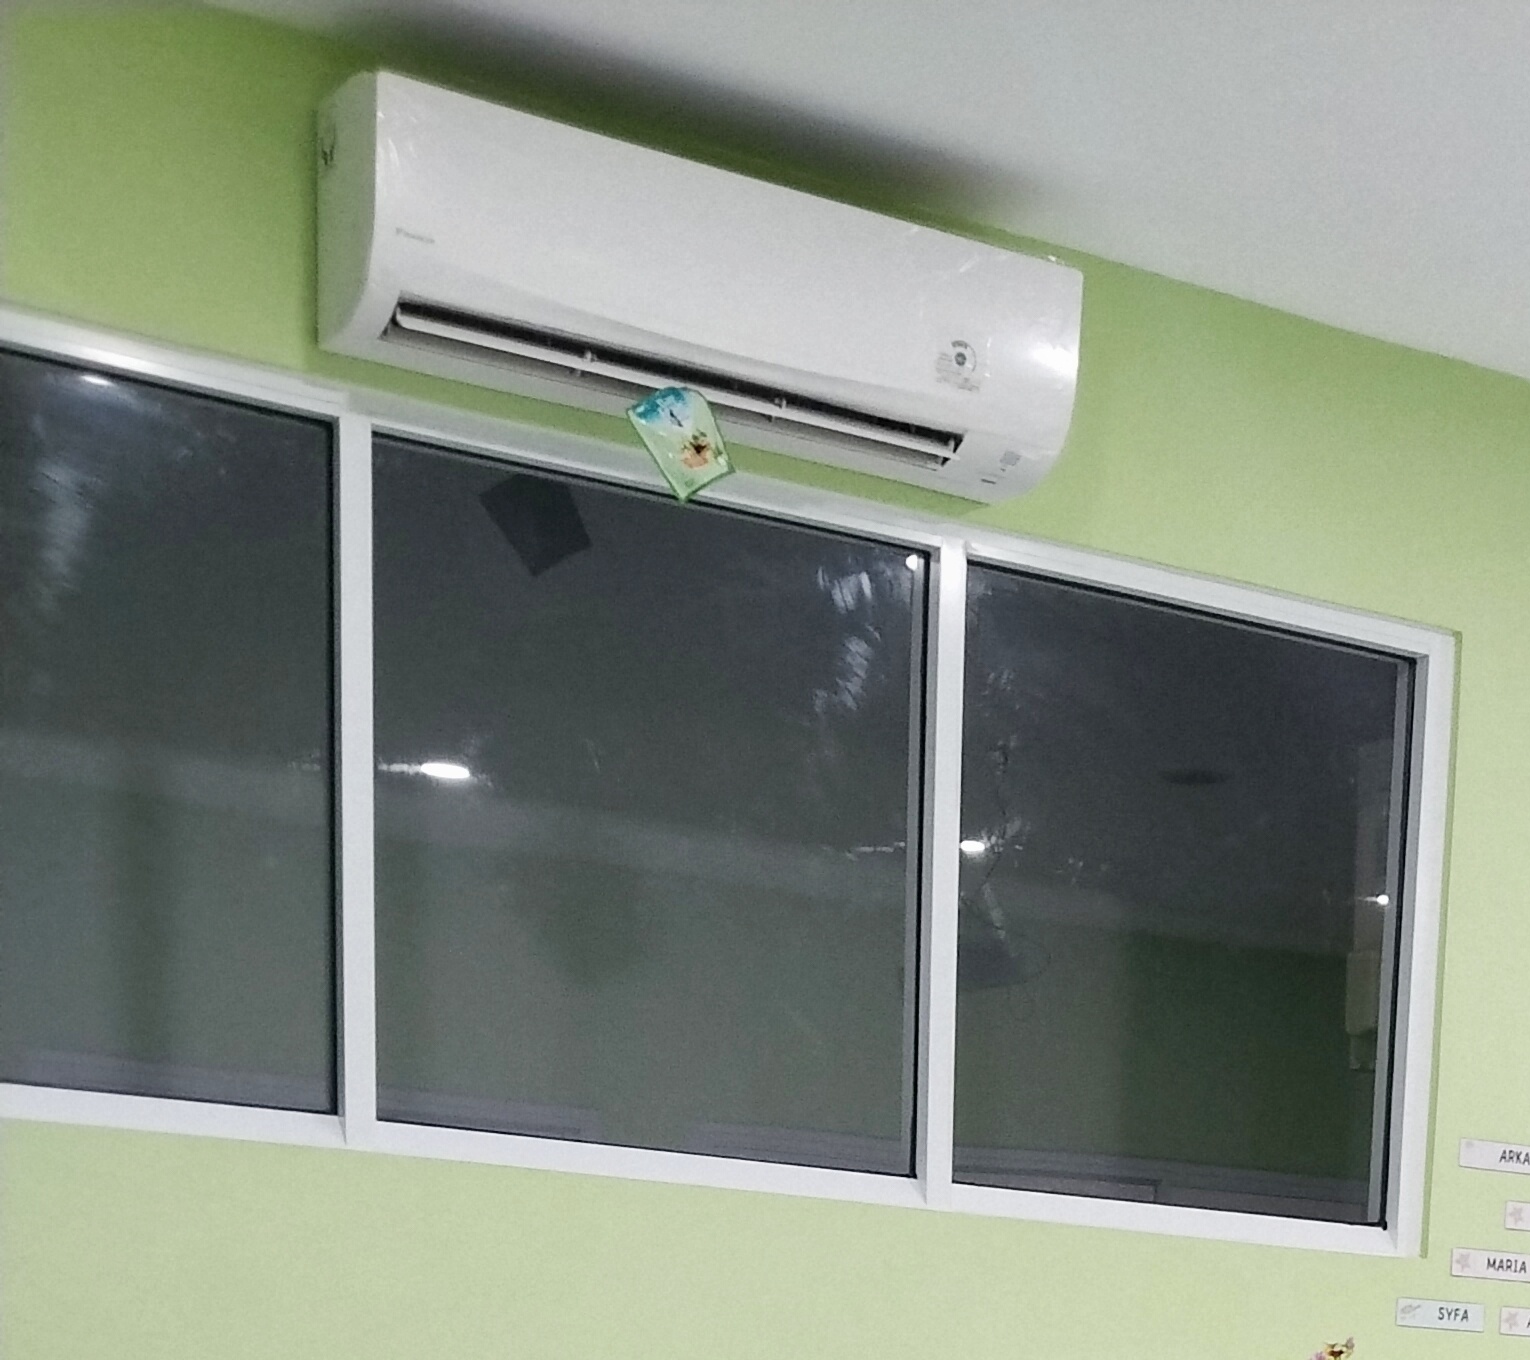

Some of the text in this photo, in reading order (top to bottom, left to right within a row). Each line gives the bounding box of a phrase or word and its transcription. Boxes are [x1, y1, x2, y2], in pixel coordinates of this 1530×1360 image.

[1499, 1150, 1530, 1166] ARKA
[1486, 1257, 1527, 1275] MARIA
[1437, 1306, 1469, 1323] SYFA
